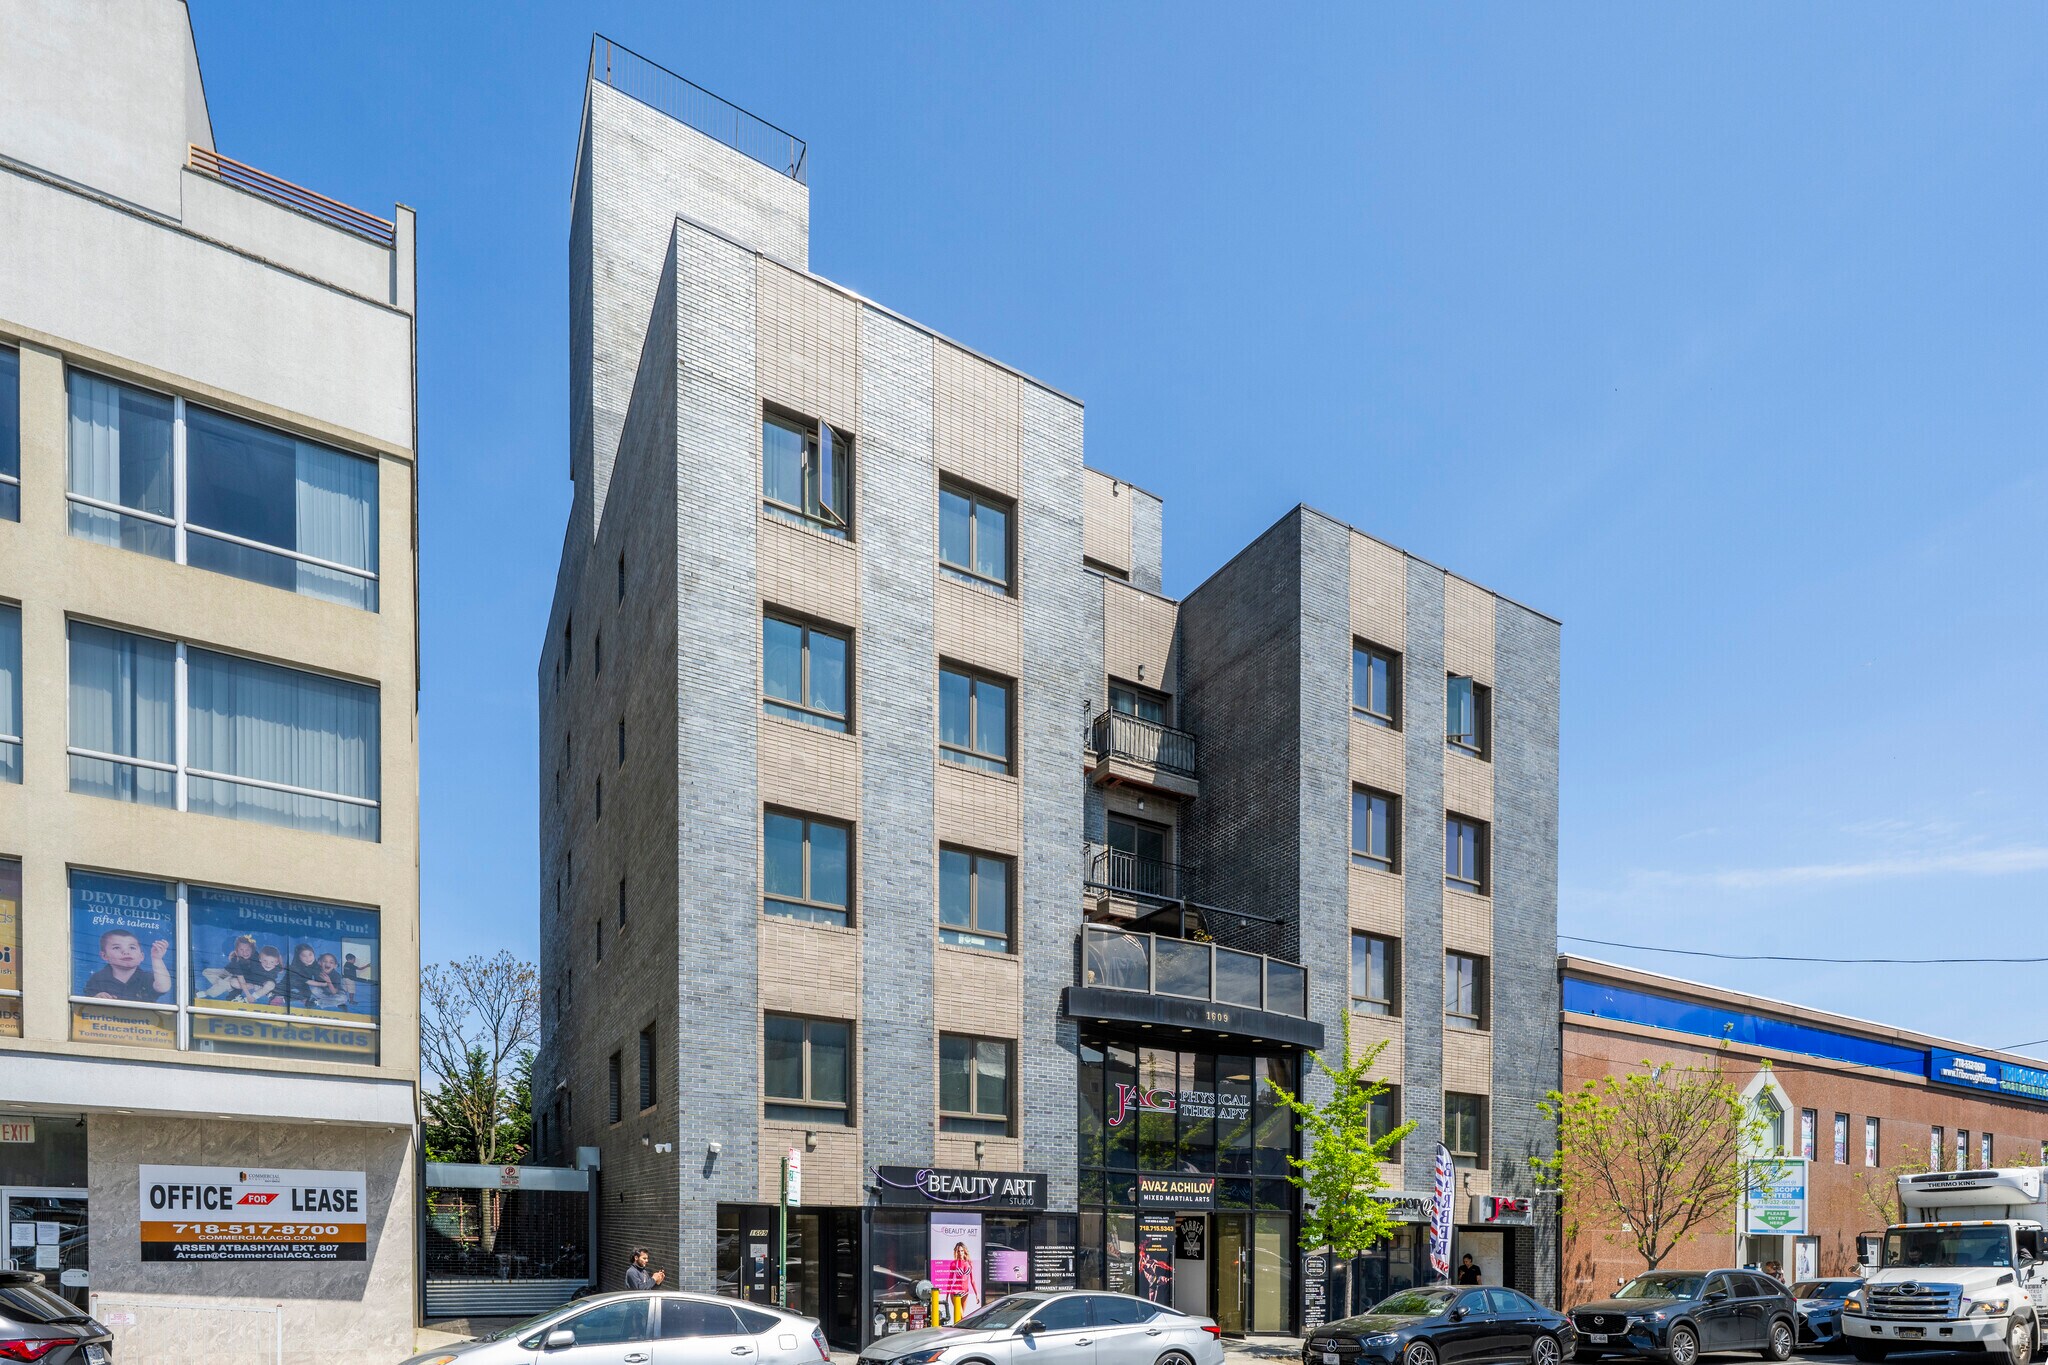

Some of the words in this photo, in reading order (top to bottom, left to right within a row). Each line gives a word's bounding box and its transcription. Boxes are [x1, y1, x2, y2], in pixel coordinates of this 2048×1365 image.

[81, 889, 163, 910] DEVELOP
[88, 903, 122, 916] YOUR
[124, 908, 171, 921] CHILD'S
[92, 914, 115, 925] gifts
[116, 917, 125, 926] &
[127, 918, 160, 930] talents
[239, 907, 312, 926] Disguised
[315, 919, 331, 929] as
[335, 919, 369, 934] Fun!
[81, 1012, 151, 1025] Enrichment
[1206, 1011, 1229, 1023] 1609
[79, 1030, 133, 1040] Tomorrow's
[136, 1035, 173, 1044] Leaders
[92, 1023, 153, 1035] Education
[208, 1018, 369, 1047] FasTracKids
[1108, 1082, 1177, 1126] JAG
[1180, 1089, 1251, 1107] PHYSICAL
[1180, 1103, 1249, 1120] THERAPY
[2, 1124, 30, 1141] EXIT
[928, 1174, 999, 1195] BEAUTY
[1001, 1178, 1037, 1197] ART
[1141, 1180, 1168, 1192] AVAZ
[1170, 1181, 1213, 1194] ACHILOV
[150, 1184, 233, 1211] OFFICE
[248, 1195, 267, 1204] FOR
[291, 1188, 358, 1213] LEASE
[172, 1224, 339, 1235] 718-517-8700
[176, 1252, 337, 1260] Arsen@CommercialACQ.com
[219, 1244, 289, 1252] ATBASHYAN
[292, 1244, 316, 1252] EXT.
[319, 1244, 339, 1252] 807
